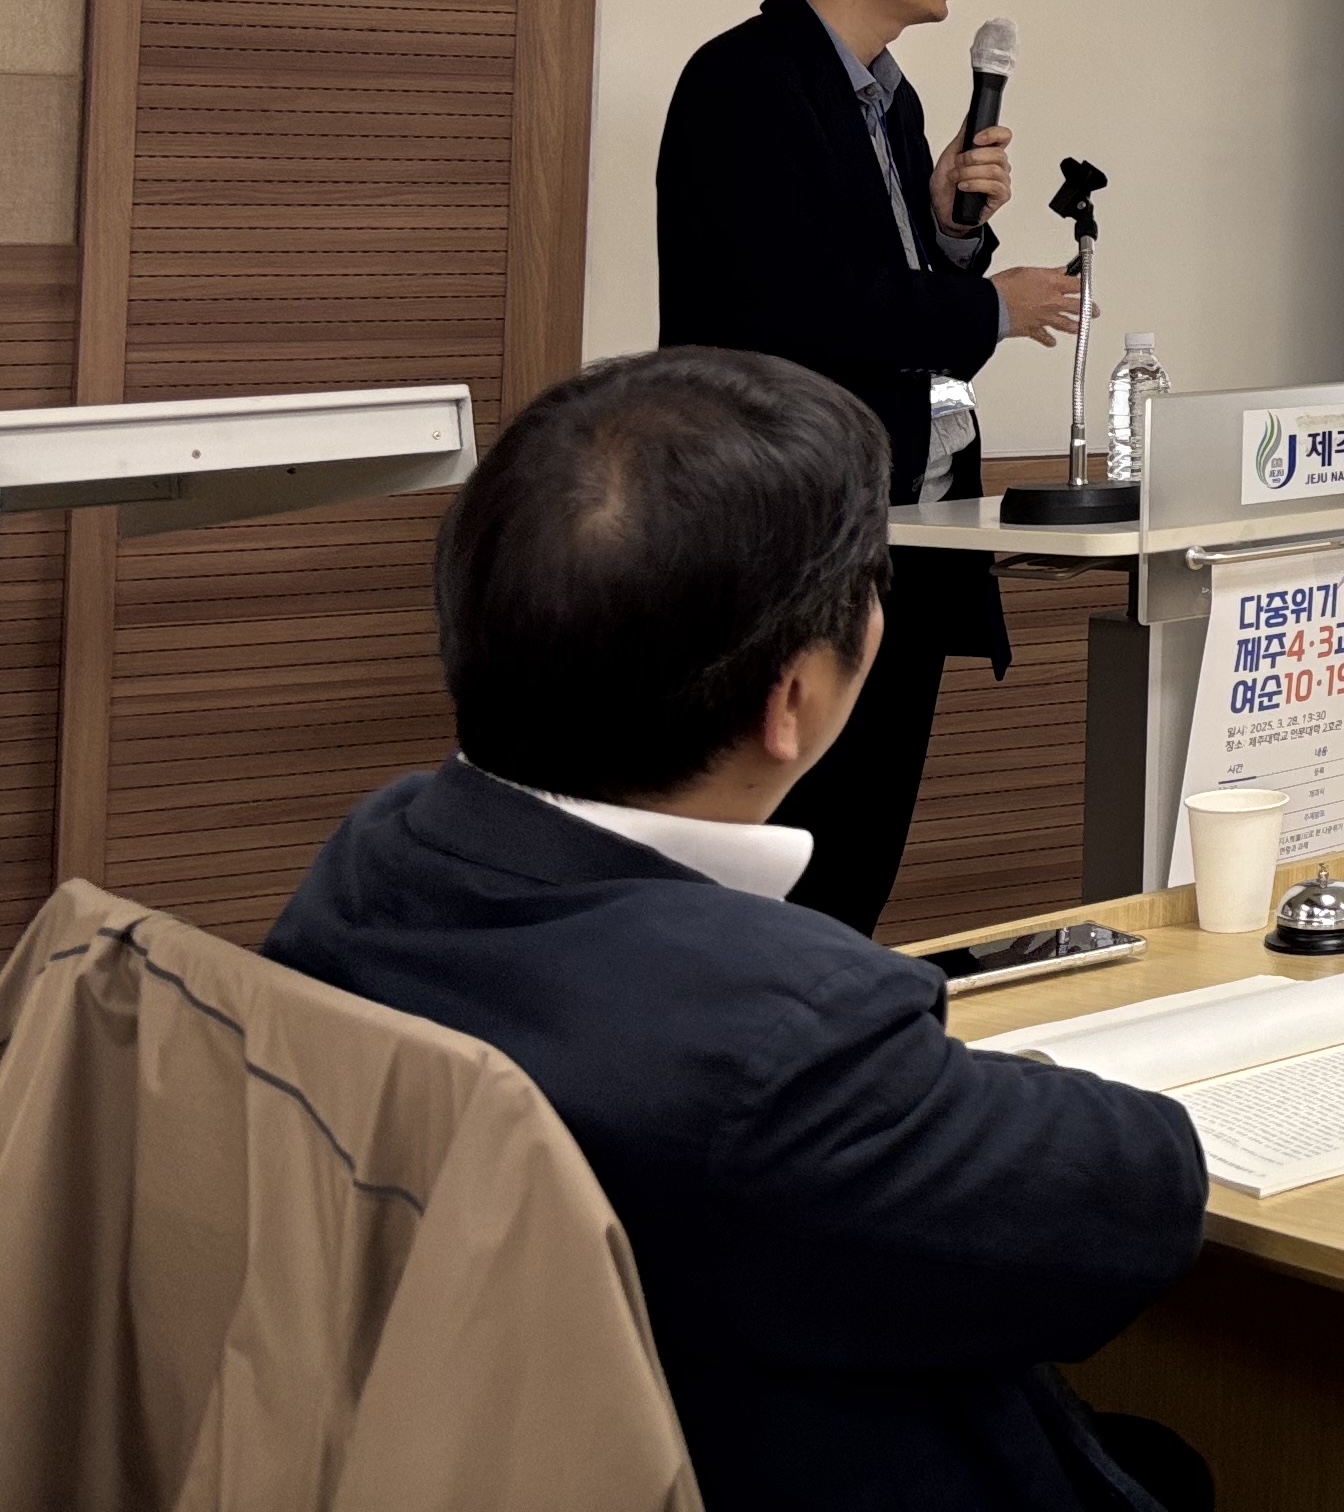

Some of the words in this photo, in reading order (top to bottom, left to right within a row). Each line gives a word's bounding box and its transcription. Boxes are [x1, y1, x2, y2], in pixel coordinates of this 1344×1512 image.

[1305, 471, 1328, 485] JEJU
[1239, 583, 1338, 630] 다중위기
[1225, 740, 1246, 752] 장소:
[1249, 731, 1288, 747] 제주대학교
[1227, 763, 1243, 774] 시간
